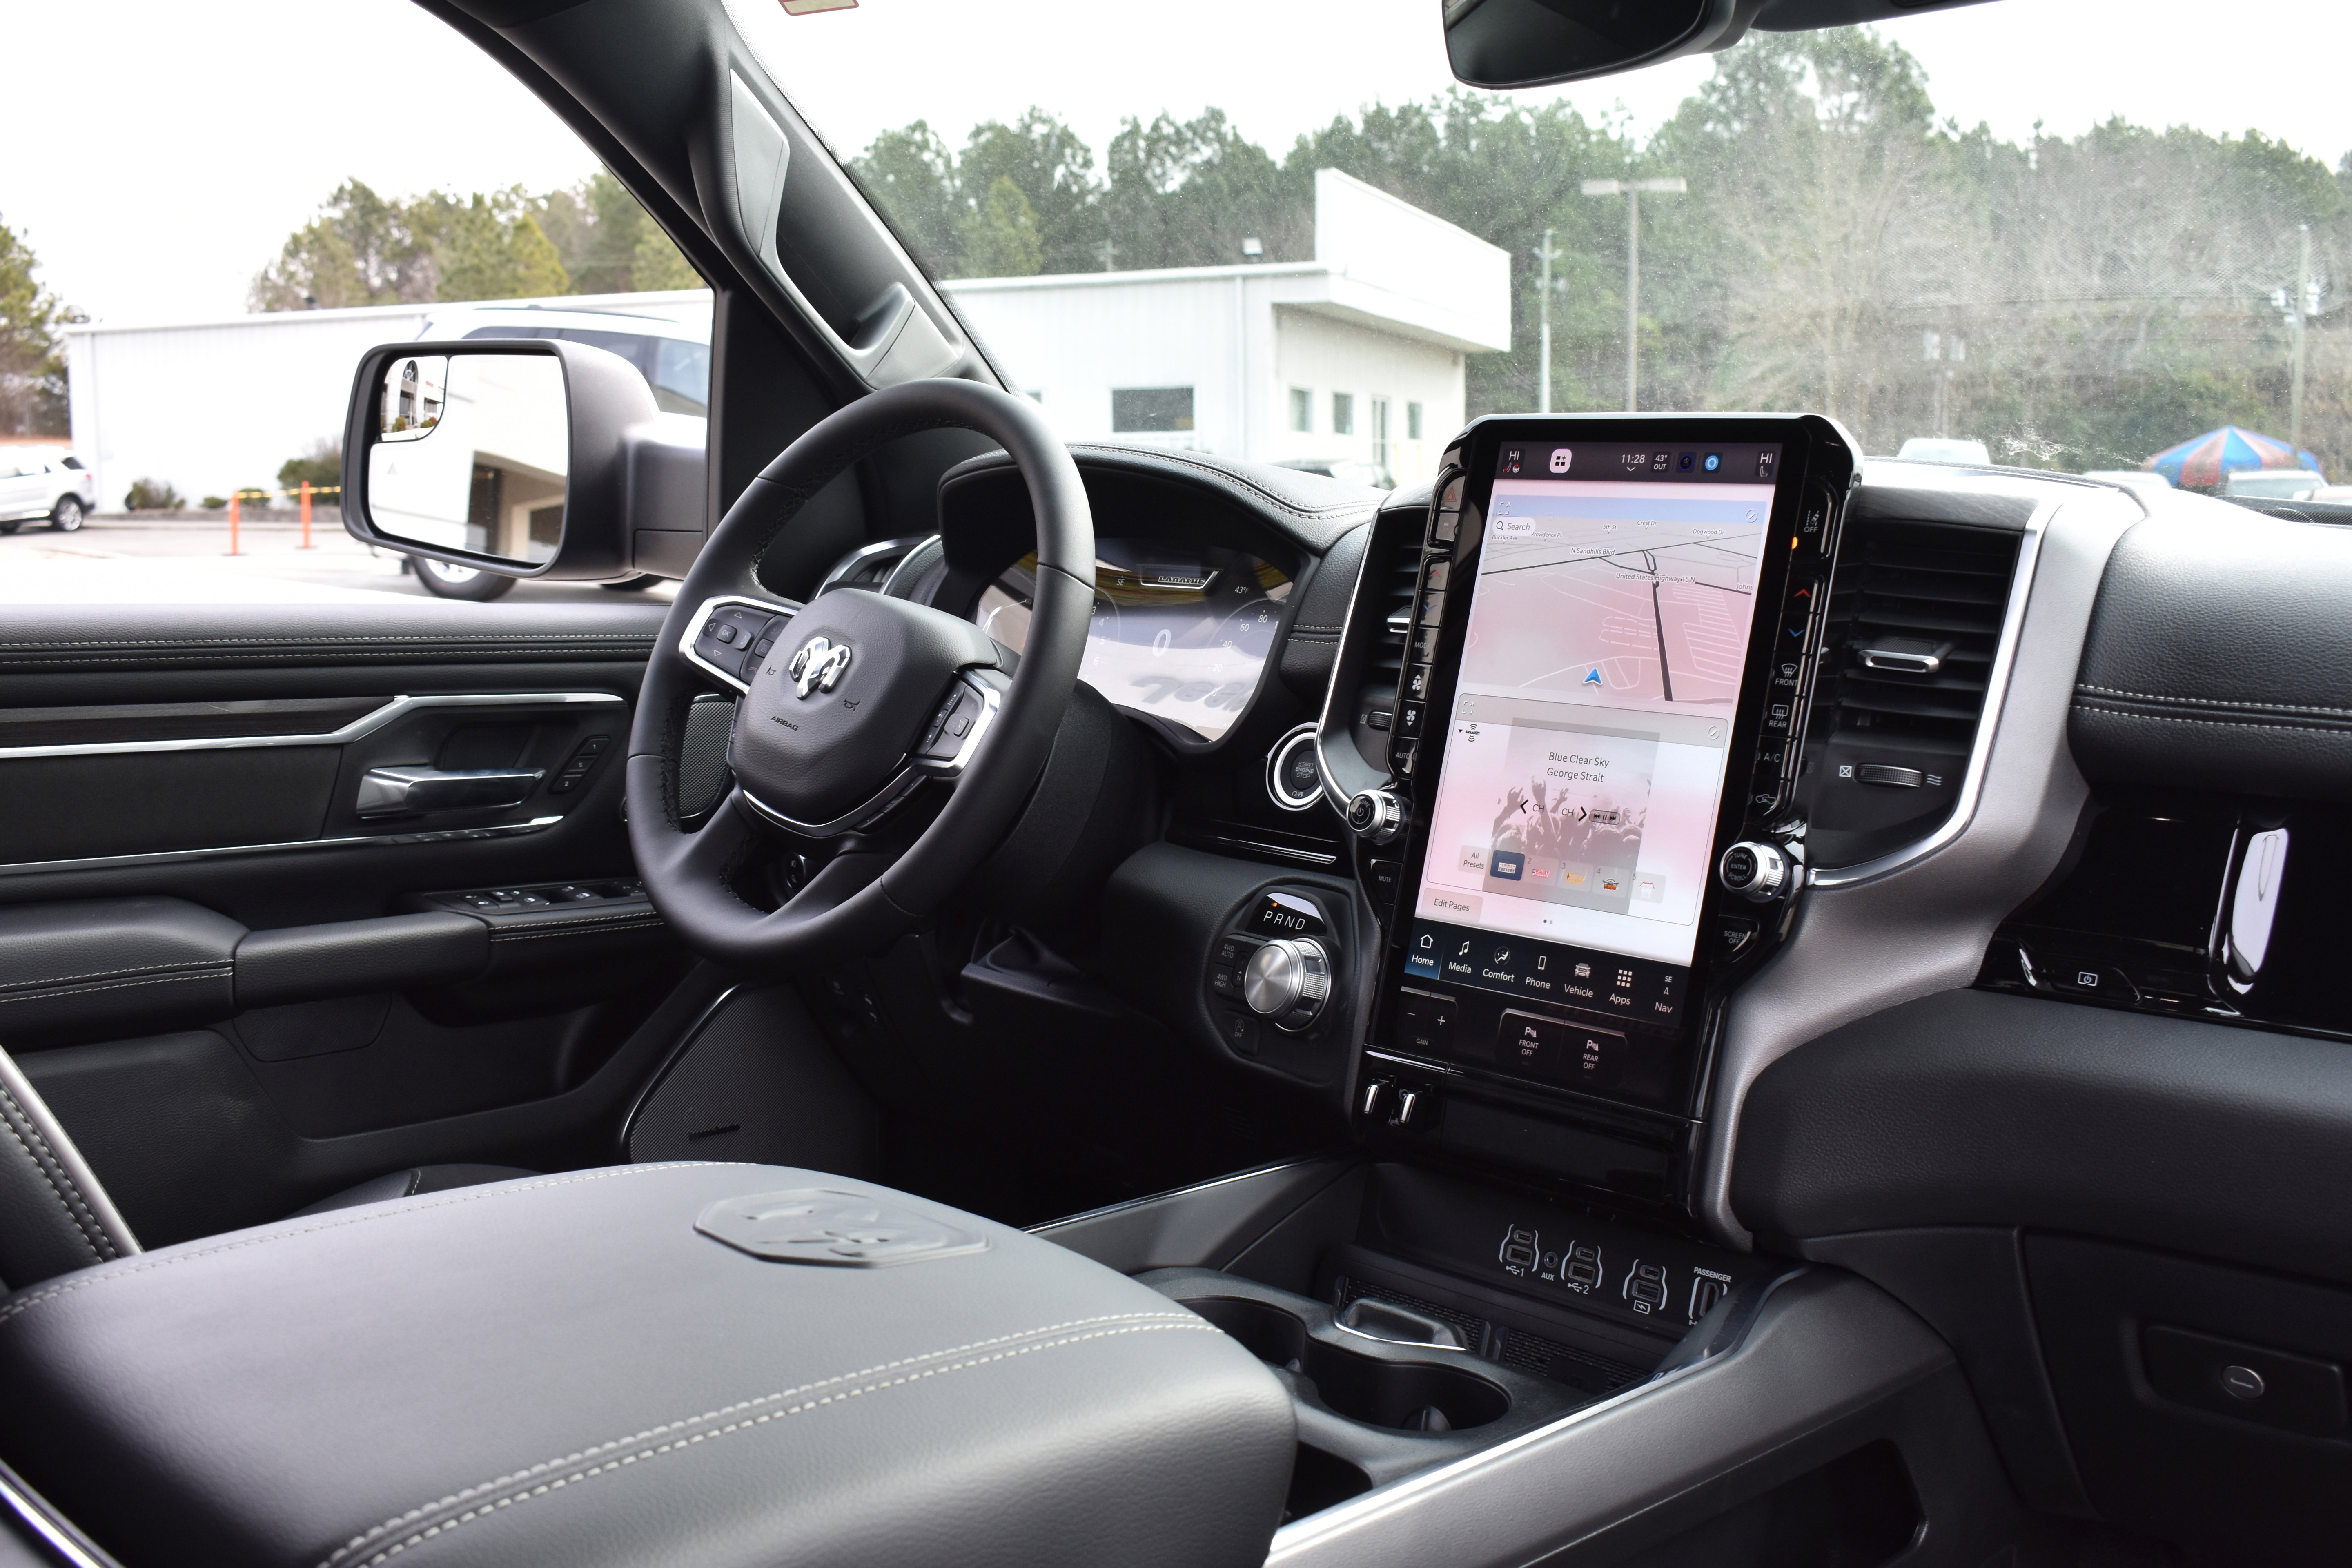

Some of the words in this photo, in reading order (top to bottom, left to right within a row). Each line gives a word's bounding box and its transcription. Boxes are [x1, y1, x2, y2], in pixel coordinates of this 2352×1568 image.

[1509, 451, 1519, 461] HI
[1621, 454, 1645, 463] 11:28
[1760, 453, 1773, 463] HI
[1158, 576, 1205, 585] LARAMIE
[1092, 606, 1096, 615] 3
[1098, 618, 1104, 627] 4
[1100, 636, 1106, 644] 5
[1153, 629, 1171, 657] 0
[1094, 657, 1099, 665] 6
[771, 716, 798, 731] AIRBAG
[1768, 720, 1787, 728] REAR
[1549, 752, 1568, 762] Blue
[1570, 755, 1592, 765] Clear
[1594, 757, 1609, 768] Sky
[1763, 753, 1781, 762] A/C
[1547, 768, 1578, 780] George
[1580, 771, 1604, 782] Strait
[1532, 804, 1545, 813] CH
[1561, 808, 1574, 817] CH
[1463, 860, 1485, 869] Presets
[1728, 872, 1747, 881] SCROLL
[1434, 898, 1448, 907] Edit
[1449, 901, 1470, 911] Pages
[1724, 931, 1747, 939] SCREEN
[1221, 950, 1234, 958] AUTO
[1412, 954, 1434, 966] Home
[1448, 962, 1471, 973] Media
[1483, 969, 1514, 982] Comfort
[1526, 977, 1550, 989] Phone
[1564, 984, 1593, 998] Vehicle
[1609, 993, 1630, 1006] Apps
[1655, 1002, 1672, 1013] Nav
[1519, 1039, 1539, 1049] FRONT
[1583, 1054, 1599, 1062] REAR
[1583, 1062, 1595, 1070] OFF
[1520, 1268, 1524, 1277] 1
[1541, 1272, 1555, 1281] AUX
[1693, 1266, 1731, 1283] PASSENGER
[1583, 1285, 1589, 1294] 2
